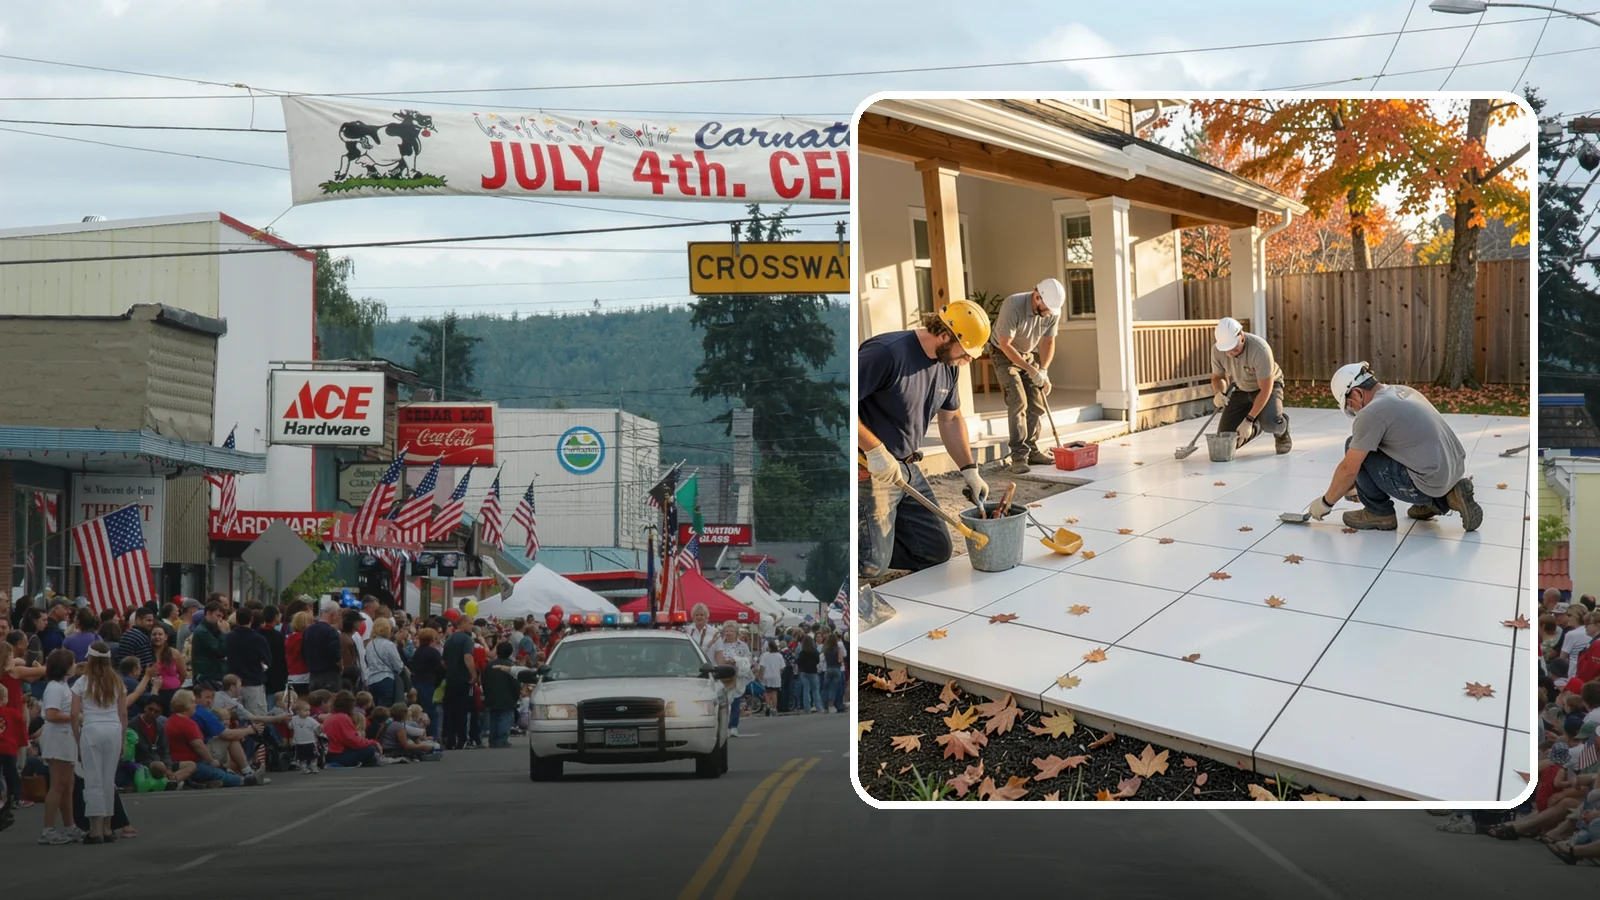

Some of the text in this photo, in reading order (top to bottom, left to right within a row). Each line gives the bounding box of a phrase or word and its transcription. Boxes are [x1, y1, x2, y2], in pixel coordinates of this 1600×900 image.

[481, 141, 605, 192] JULY
[632, 150, 746, 197] 4th.
[697, 254, 850, 280] CROSSWA
[283, 380, 373, 420] ACE
[406, 409, 453, 422] CEDAR
[283, 421, 371, 437] Hardware
[416, 428, 477, 447] Coca-Cola
[353, 467, 387, 482] Simpl
[96, 485, 124, 494] Vincent
[127, 485, 136, 494] de
[137, 486, 155, 495] Paul
[81, 503, 154, 522] THT
[688, 526, 741, 536] CRNATION
[699, 535, 730, 543] GLASS
